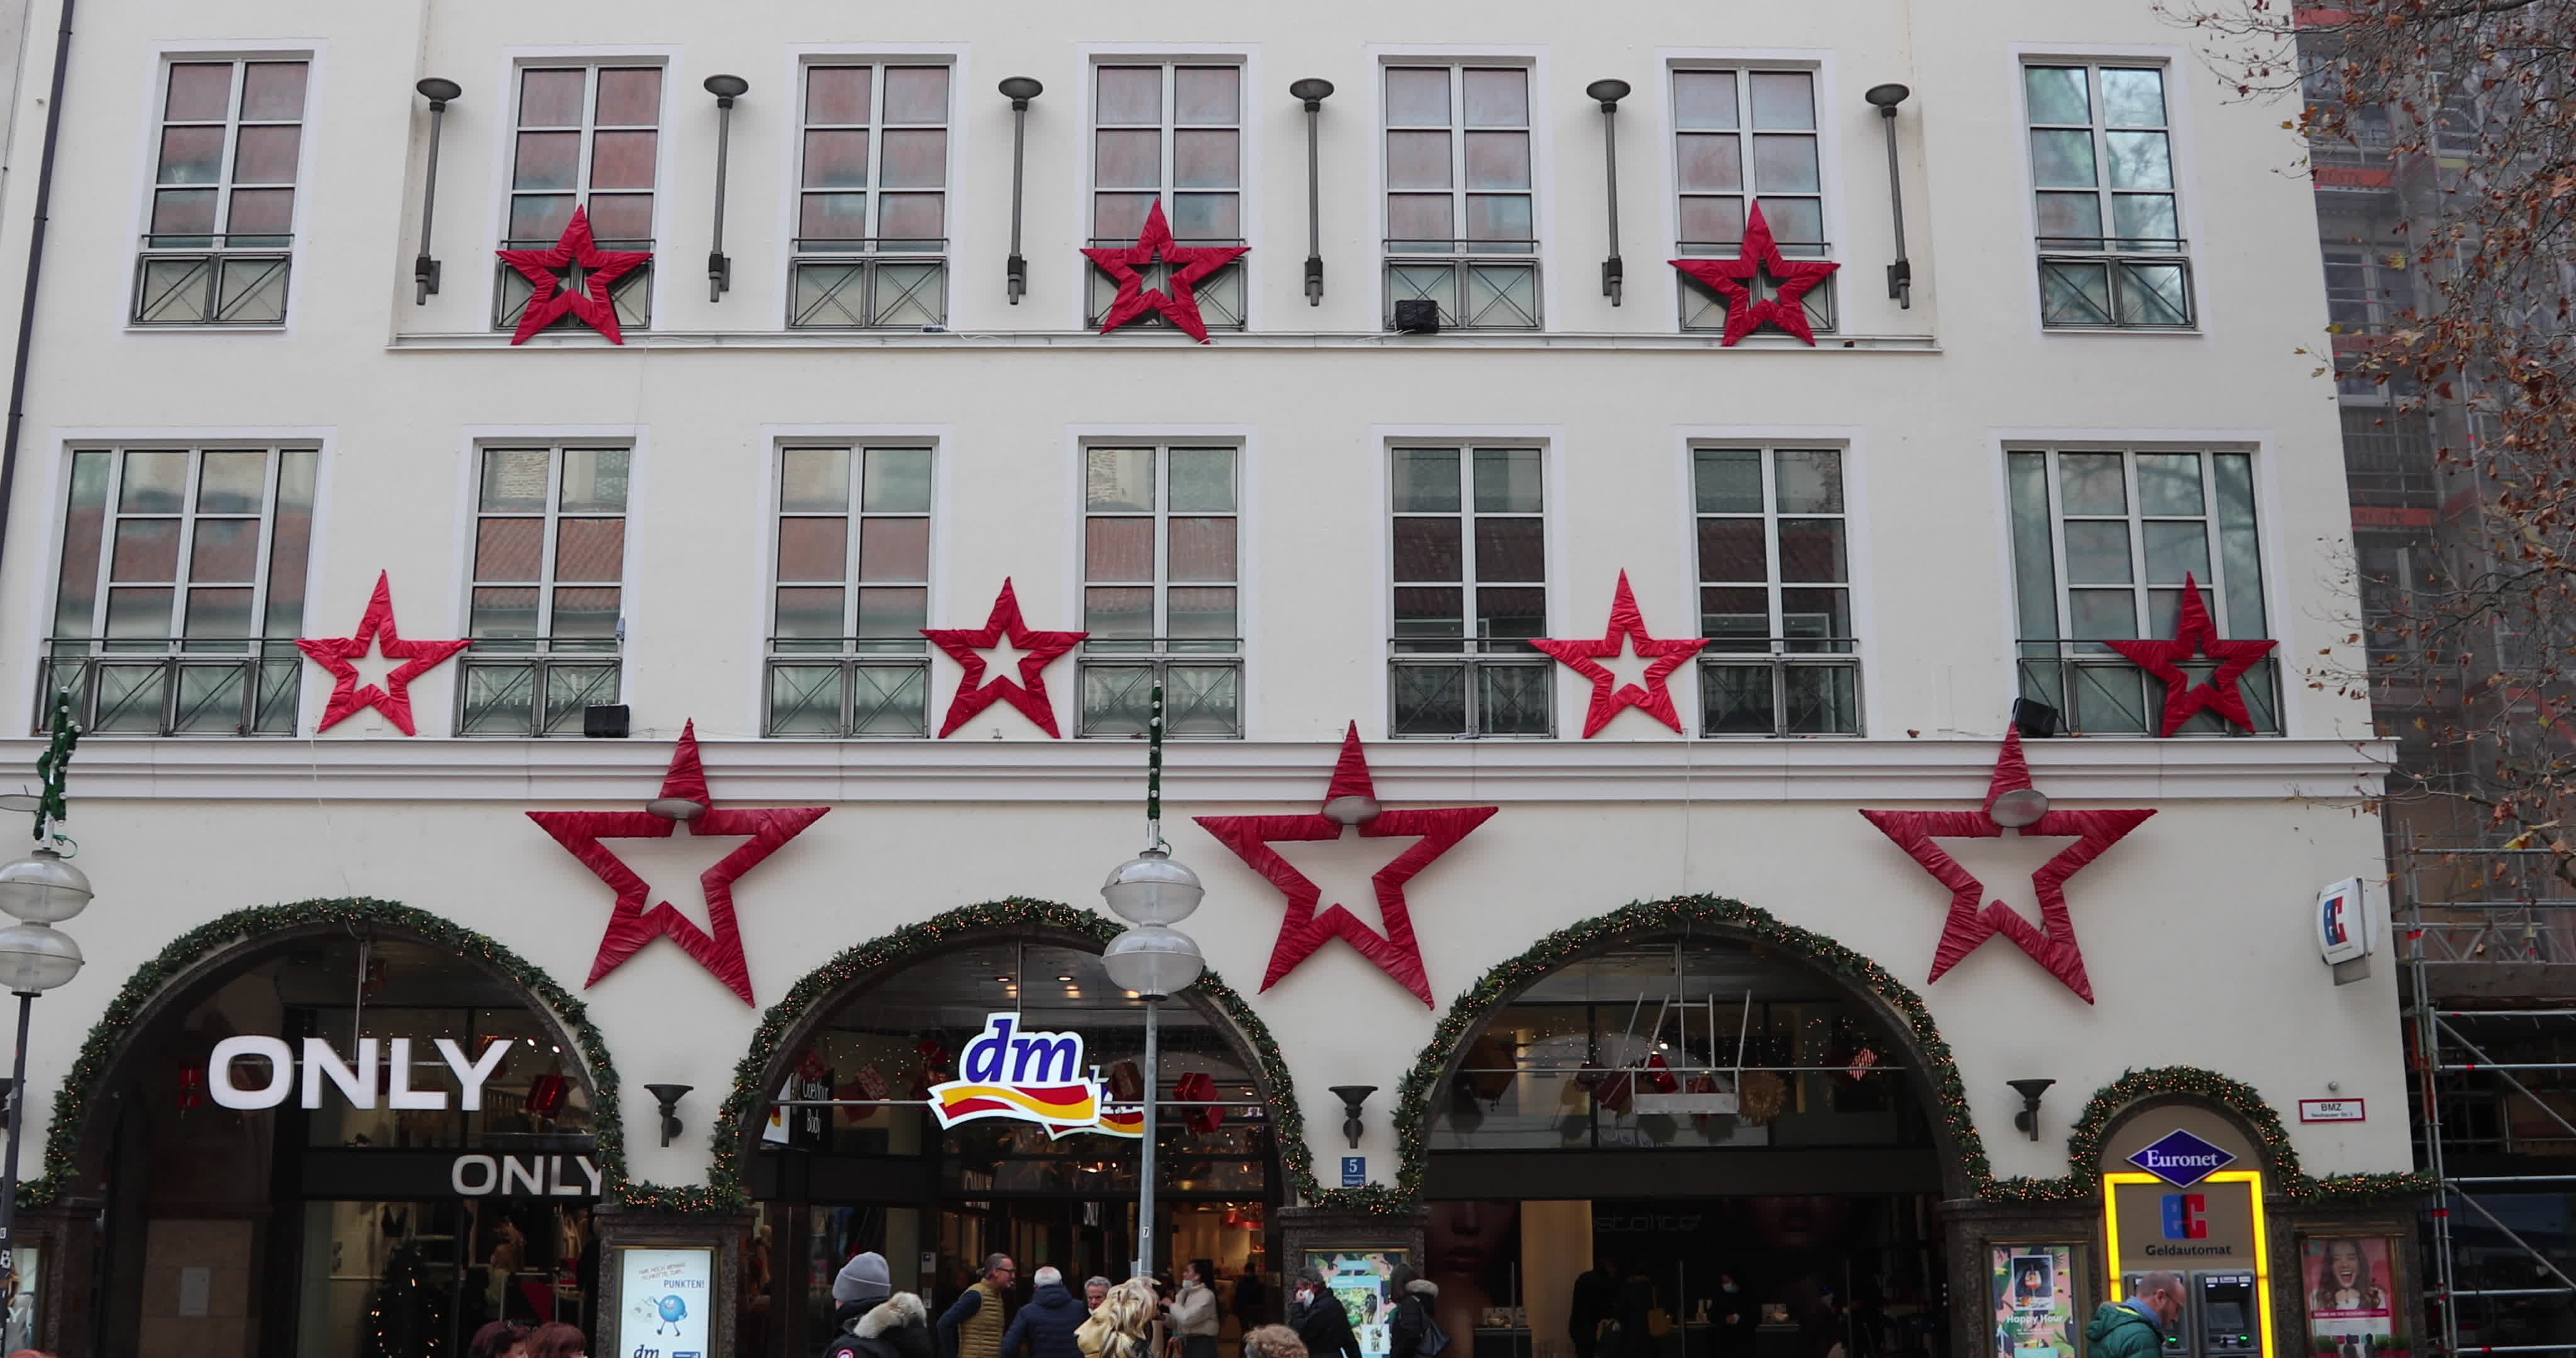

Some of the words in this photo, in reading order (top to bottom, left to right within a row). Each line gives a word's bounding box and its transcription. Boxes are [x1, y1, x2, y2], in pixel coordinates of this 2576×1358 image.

[966, 1019, 1077, 1082] dm
[208, 1035, 513, 1111] ONLY
[2321, 1103, 2342, 1112] BMZ
[1349, 1159, 1358, 1173] 5
[2146, 1150, 2219, 1168] Euronet
[452, 1154, 601, 1196] ONLY
[2145, 1245, 2232, 1256] Geldautomat
[663, 1279, 705, 1288] PUNKTEN!
[2007, 1314, 2040, 1325] Happy
[2041, 1314, 2063, 1323] Hour
[634, 1344, 660, 1358] dm
